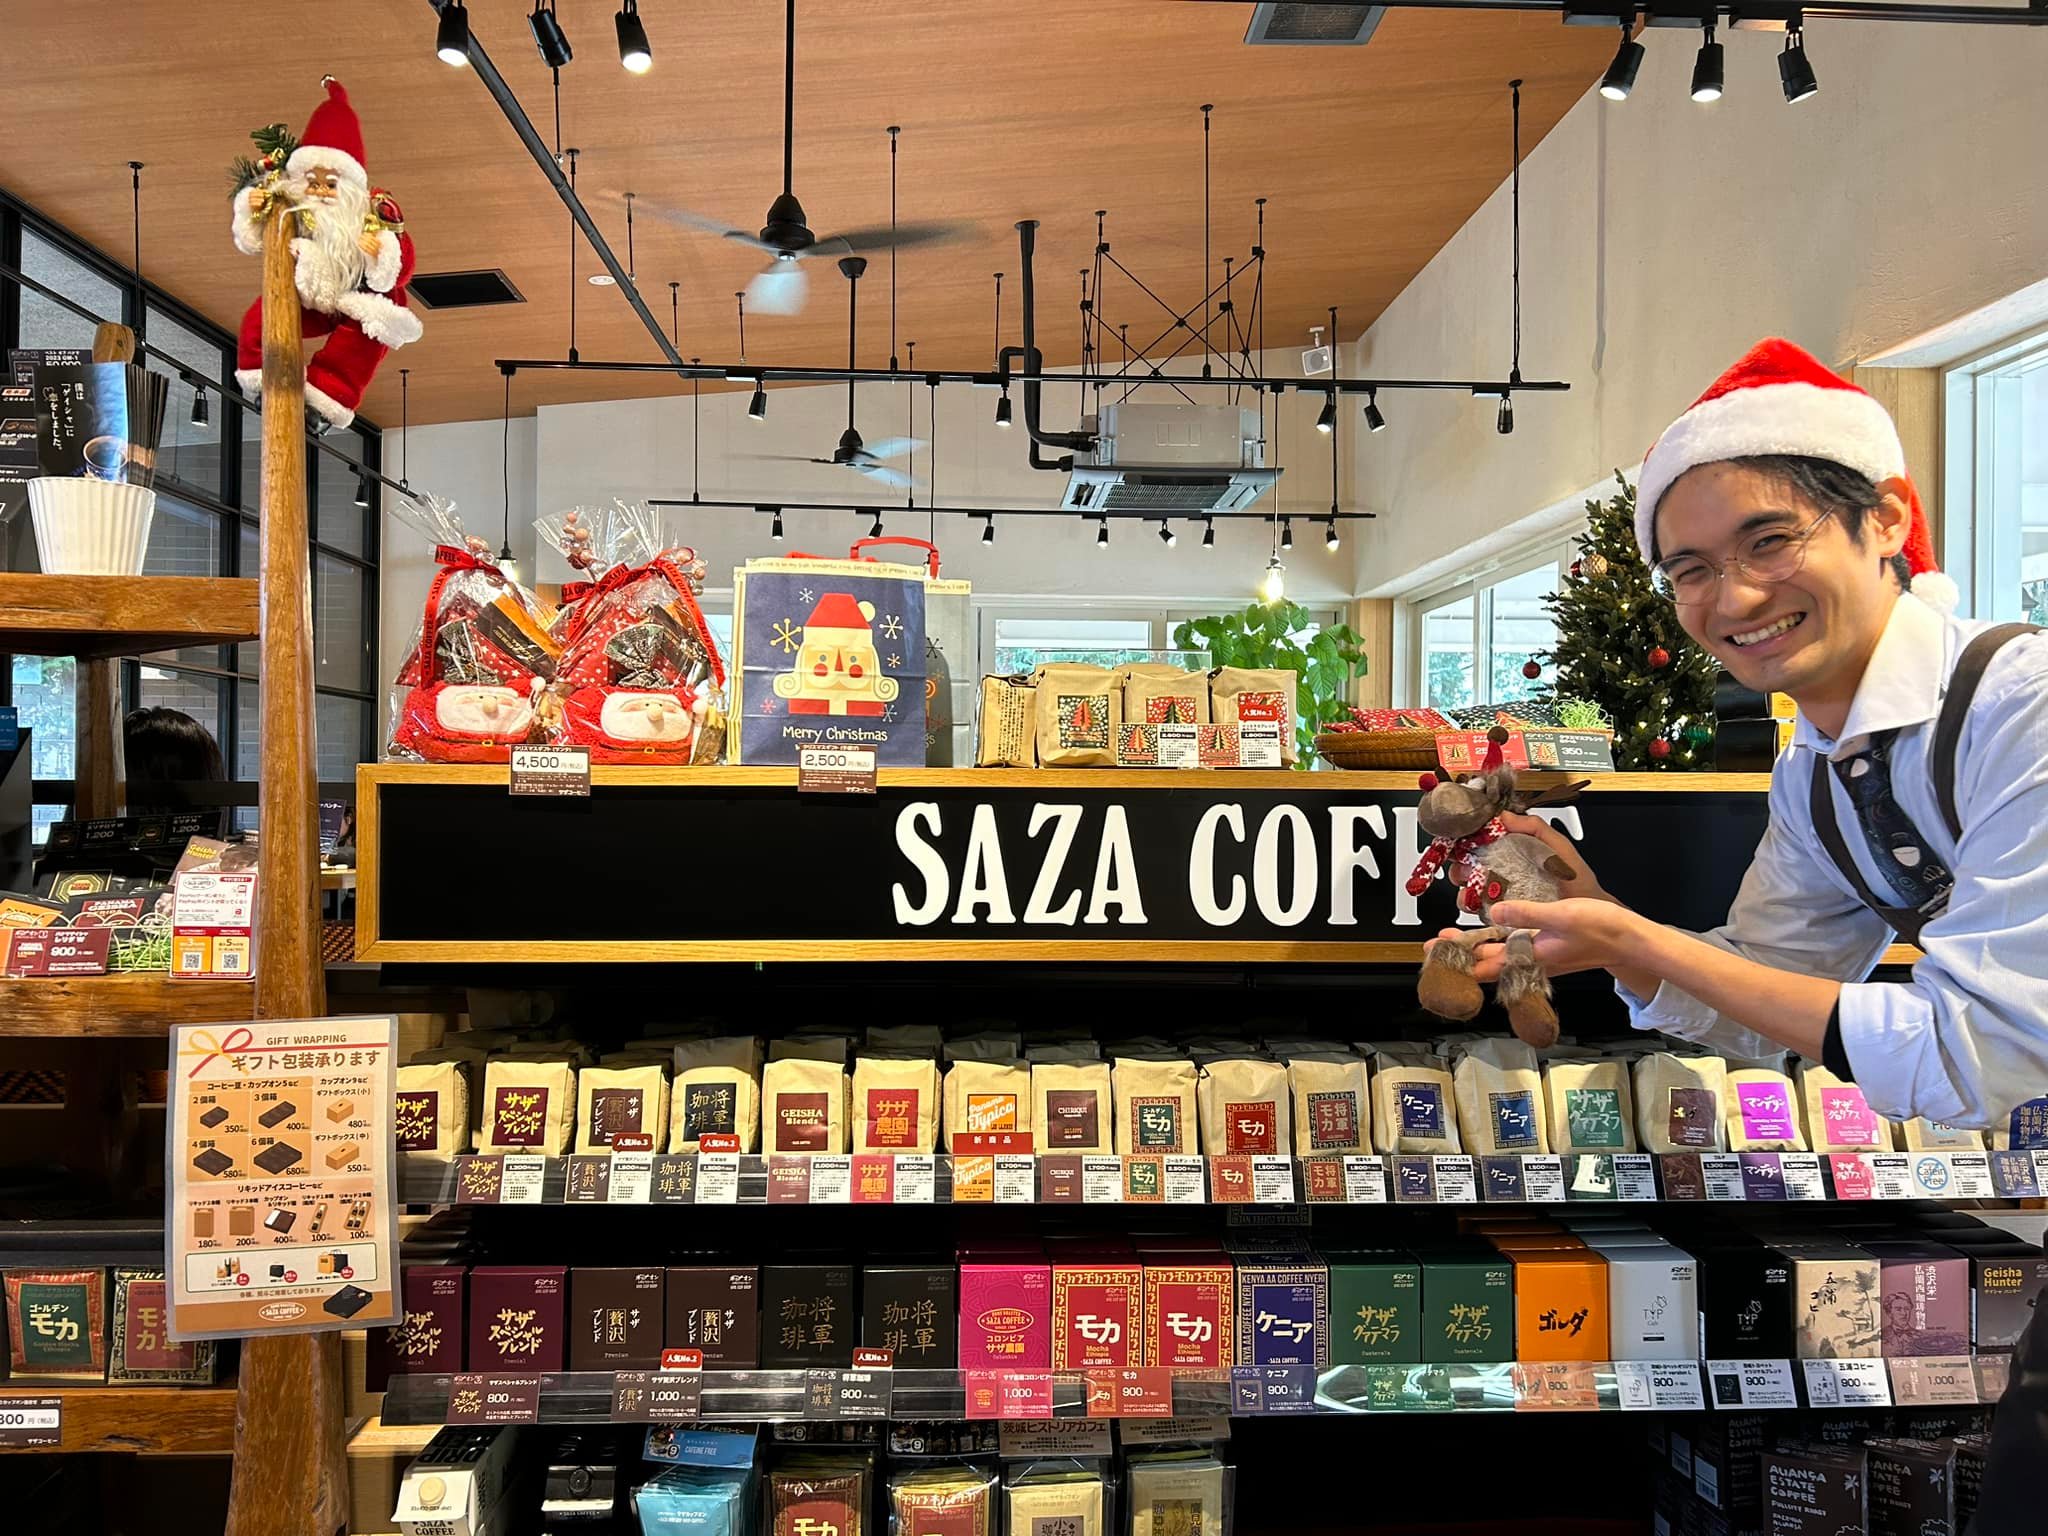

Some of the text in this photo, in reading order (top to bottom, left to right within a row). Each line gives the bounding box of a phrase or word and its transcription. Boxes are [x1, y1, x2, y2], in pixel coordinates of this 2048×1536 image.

[783, 726, 888, 744] Merry Christmas
[516, 756, 559, 768] 4,500
[805, 754, 846, 766] 2,500
[892, 802, 1148, 926] SAZA
[51, 947, 76, 956] 900
[266, 1034, 347, 1046] GIFT WRAPPING
[232, 1050, 380, 1071] ギフト包装承ります
[504, 1092, 540, 1111] サザ
[627, 1097, 639, 1120] サザ
[876, 1100, 910, 1116] サザ
[1404, 1094, 1434, 1116] ケニア
[1571, 1090, 1614, 1112] サザ
[594, 1097, 605, 1136] ブレンド
[689, 1090, 709, 1130] 珈琲
[710, 1089, 731, 1130] 将軍
[780, 1109, 824, 1118] GEISHA
[968, 1103, 1016, 1130] Typica
[348, 1120, 362, 1128] 480
[498, 1110, 542, 1125] スペシャル
[786, 1117, 818, 1126] Blends
[1142, 1114, 1170, 1132] モカ
[1320, 1104, 1332, 1132] モカ
[1500, 1108, 1528, 1128] ケニア
[224, 1125, 240, 1133] 350
[286, 1122, 300, 1130] 400
[503, 1122, 540, 1136] ブレンド
[1237, 1120, 1264, 1136] モカ
[224, 1170, 238, 1178] 580
[348, 1164, 362, 1172] 550
[468, 1160, 498, 1174] サザ
[598, 1162, 608, 1180] サザ
[772, 1168, 807, 1176] GEISHA
[860, 1164, 887, 1178] サザ
[1132, 1169, 1155, 1184] モカ
[1221, 1169, 1244, 1184] モカ
[1402, 1166, 1428, 1184] ケニア
[1490, 1168, 1516, 1185] ケニア
[468, 1184, 498, 1195] ブレンド
[236, 1238, 250, 1246] 200
[274, 1236, 288, 1244] 400
[312, 1234, 326, 1242] 100
[350, 1231, 364, 1239] 100
[198, 1240, 213, 1248] 180
[1242, 1273, 1326, 1284] KENYA AA COFFEE NYERI
[1984, 1266, 2023, 1278] Geisha
[1984, 1278, 2022, 1287] Hunter
[1316, 1285, 1326, 1308] KENYA
[29, 1304, 70, 1313] ゴールデン
[1242, 1285, 1252, 1346] AA COFFEE NYERI
[1448, 1304, 1490, 1324] サザ
[497, 1308, 536, 1328] サザ
[630, 1308, 640, 1328] サザ
[724, 1310, 735, 1328] サザ
[780, 1296, 808, 1350] 珈琲
[808, 1296, 836, 1352] 将軍
[986, 1316, 1026, 1324] SAZA COFFEE
[1356, 1306, 1398, 1327] サザ
[1539, 1308, 1589, 1337] ゴルダ
[30, 1314, 78, 1340] モカ
[138, 1308, 158, 1350] モカ
[593, 1308, 602, 1342] ブレンド
[608, 1310, 624, 1342] 贅沢
[688, 1309, 698, 1344] ブレンド
[704, 1311, 719, 1342] 贅沢
[882, 1302, 910, 1354] 珈琲
[912, 1300, 938, 1356] 将軍
[1074, 1314, 1121, 1344] モカ
[1166, 1312, 1212, 1342] モカ
[1255, 1310, 1313, 1344] ケニア
[488, 1325, 544, 1342] スペシャル
[986, 1334, 1024, 1342] コロンビア
[1316, 1320, 1326, 1346] COFFEE
[1353, 1324, 1400, 1345] グアテマラ
[1445, 1322, 1494, 1344] グアテマラ
[498, 1339, 542, 1356] ブレンド
[1122, 1371, 1137, 1380] モカ
[1266, 1370, 1288, 1378] ケニア
[1746, 1376, 1766, 1386] 900
[1928, 1376, 1954, 1386] 1,000
[1268, 1385, 1288, 1394] 900
[1654, 1378, 1674, 1386] 900
[1841, 1378, 1860, 1387] 900
[487, 1394, 509, 1403] 800
[650, 1391, 680, 1402] 1,000
[840, 1389, 862, 1399] 900
[1004, 1388, 1032, 1398] 1,000
[1122, 1387, 1143, 1396] 900
[1241, 1388, 1257, 1400] ケニア
[1003, 1422, 1106, 1432] 茨城ヒストリアカフェ
[670, 1445, 678, 1456] 9
[914, 1440, 922, 1450] 9
